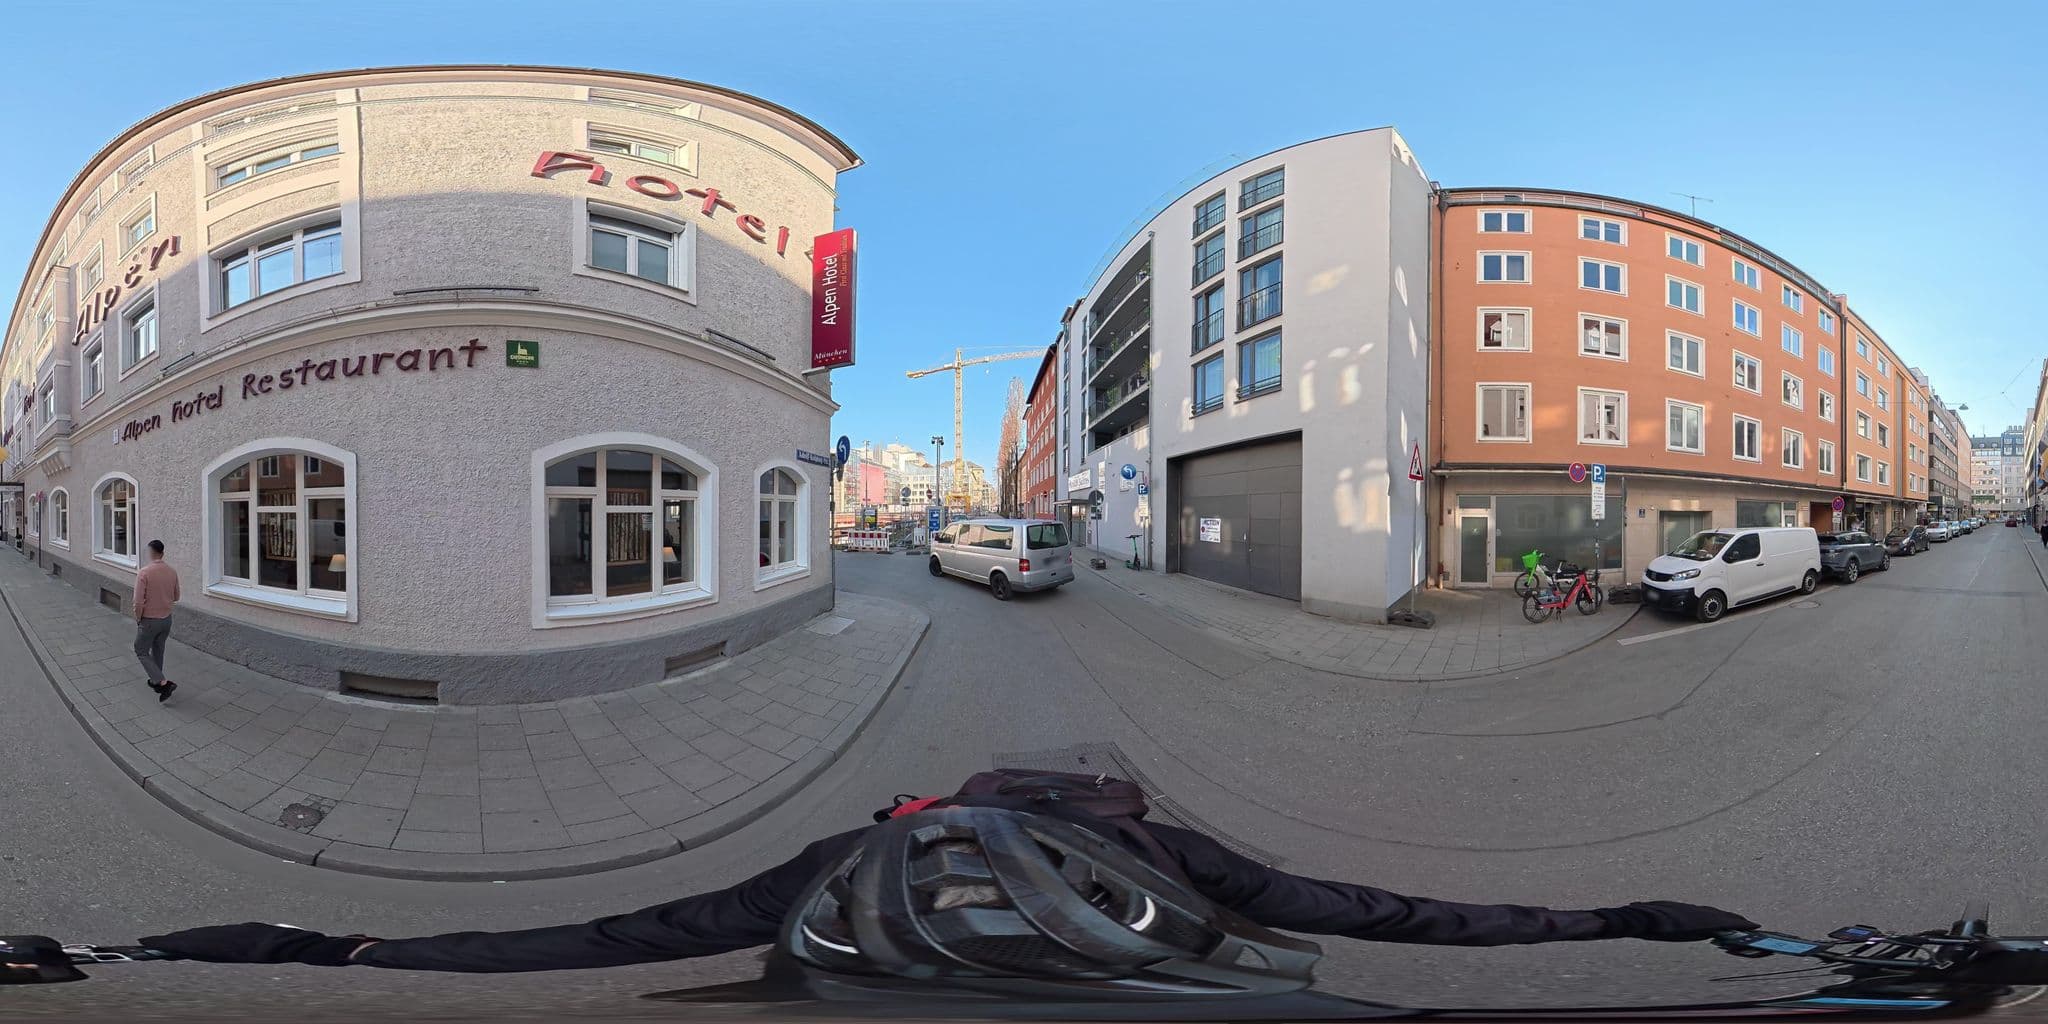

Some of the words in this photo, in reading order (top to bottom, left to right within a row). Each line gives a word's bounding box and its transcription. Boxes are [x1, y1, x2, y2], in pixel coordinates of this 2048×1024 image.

[822, 254, 838, 286] Hotel
[72, 235, 180, 345] Alpen
[821, 288, 840, 325] Alpen
[815, 349, 847, 359] München
[121, 413, 161, 443] Alpen
[242, 338, 488, 400] Restaurant
[1594, 466, 1602, 480] P
